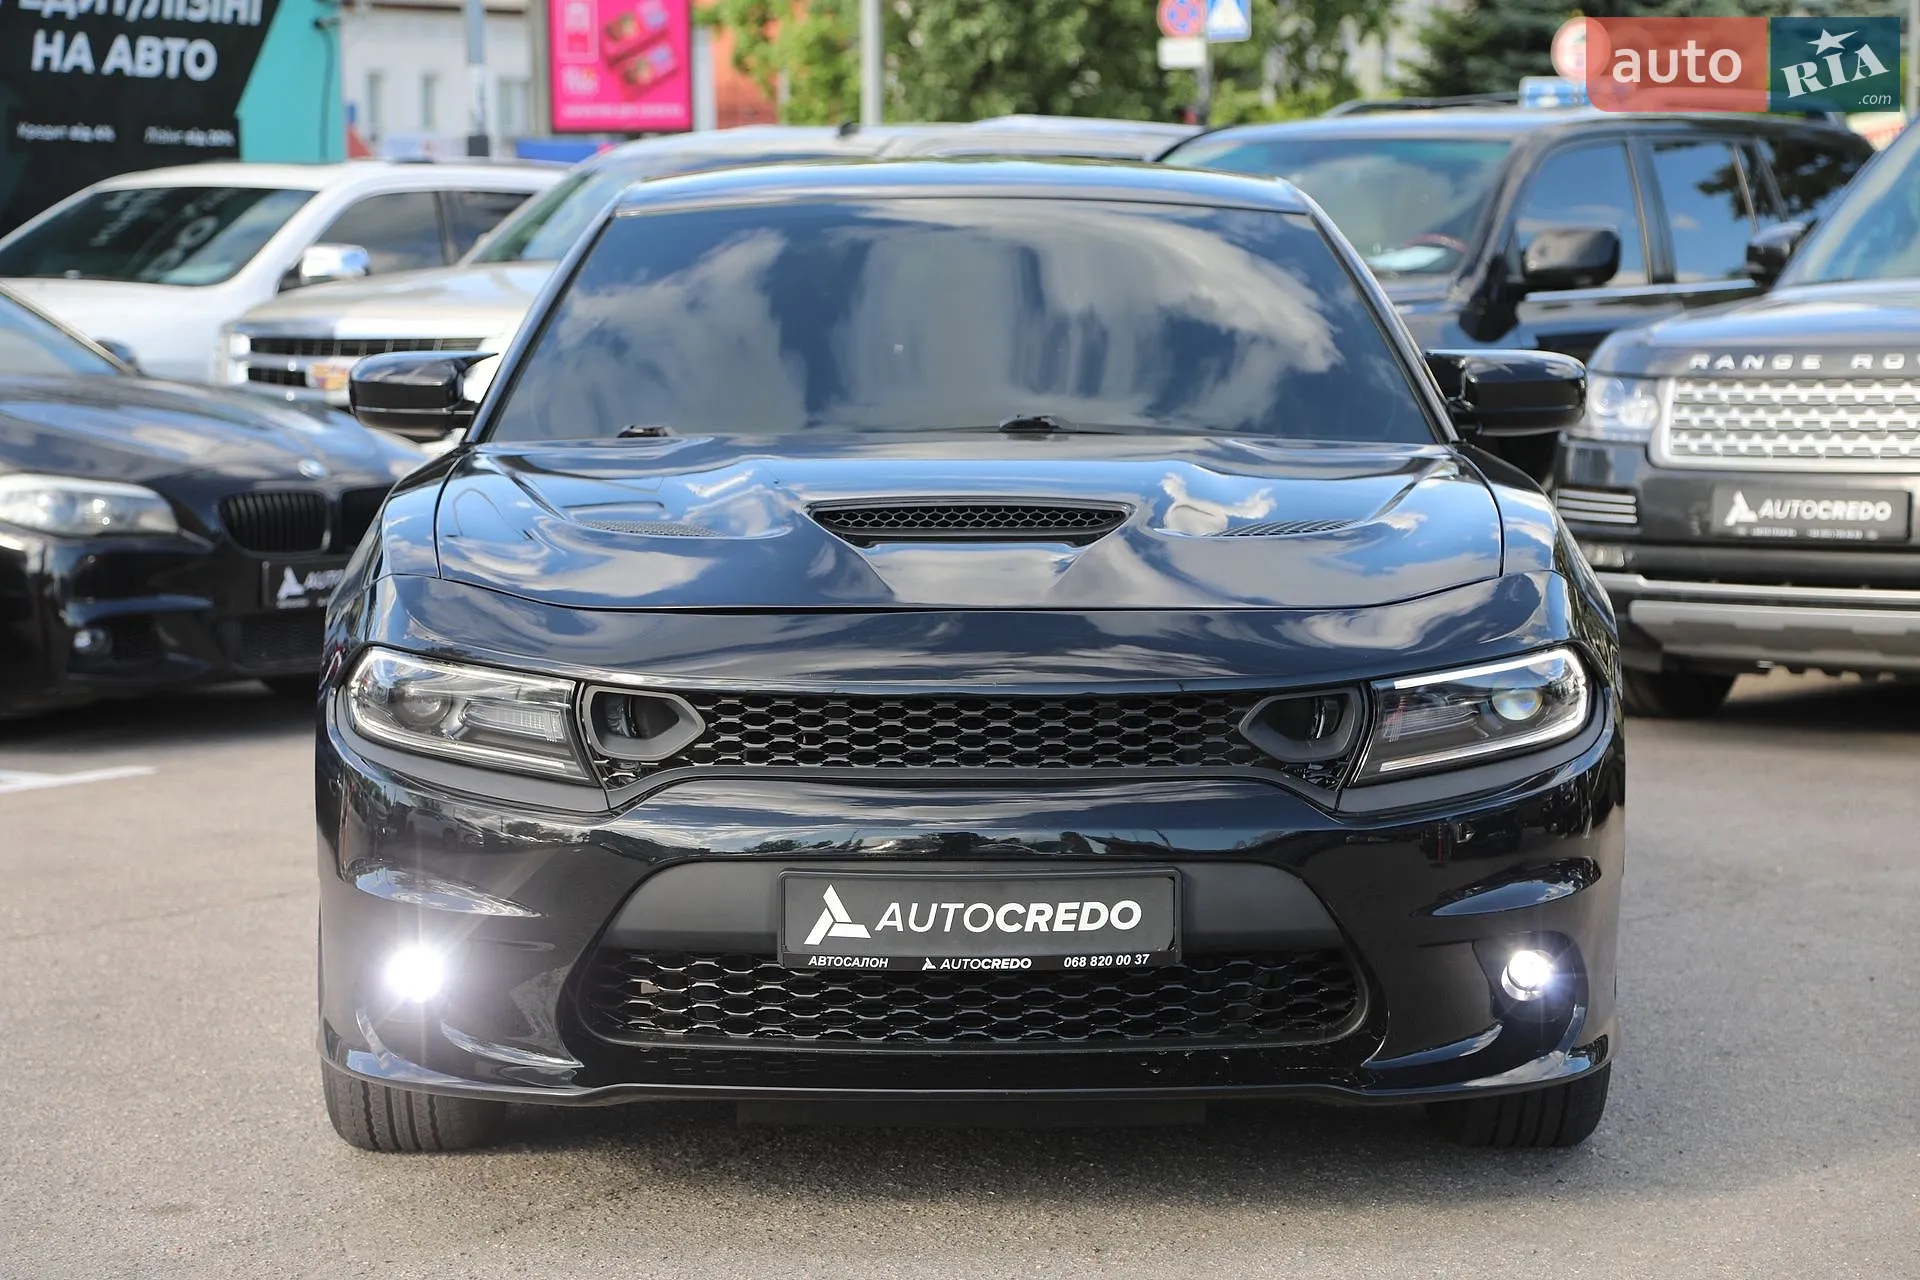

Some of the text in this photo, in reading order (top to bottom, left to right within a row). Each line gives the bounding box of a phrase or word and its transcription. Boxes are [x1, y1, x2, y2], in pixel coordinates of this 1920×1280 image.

[31, 29, 218, 82] НА АВТО
[1689, 354, 1920, 370] RANGE RO
[1758, 499, 1893, 522] AUTOCREDO
[875, 899, 1143, 933] AUTOCREDO
[808, 955, 889, 968] АВТОСАЛОН
[940, 957, 1033, 970] AUTOCREDO
[1063, 953, 1150, 968] 068 820 00 37
